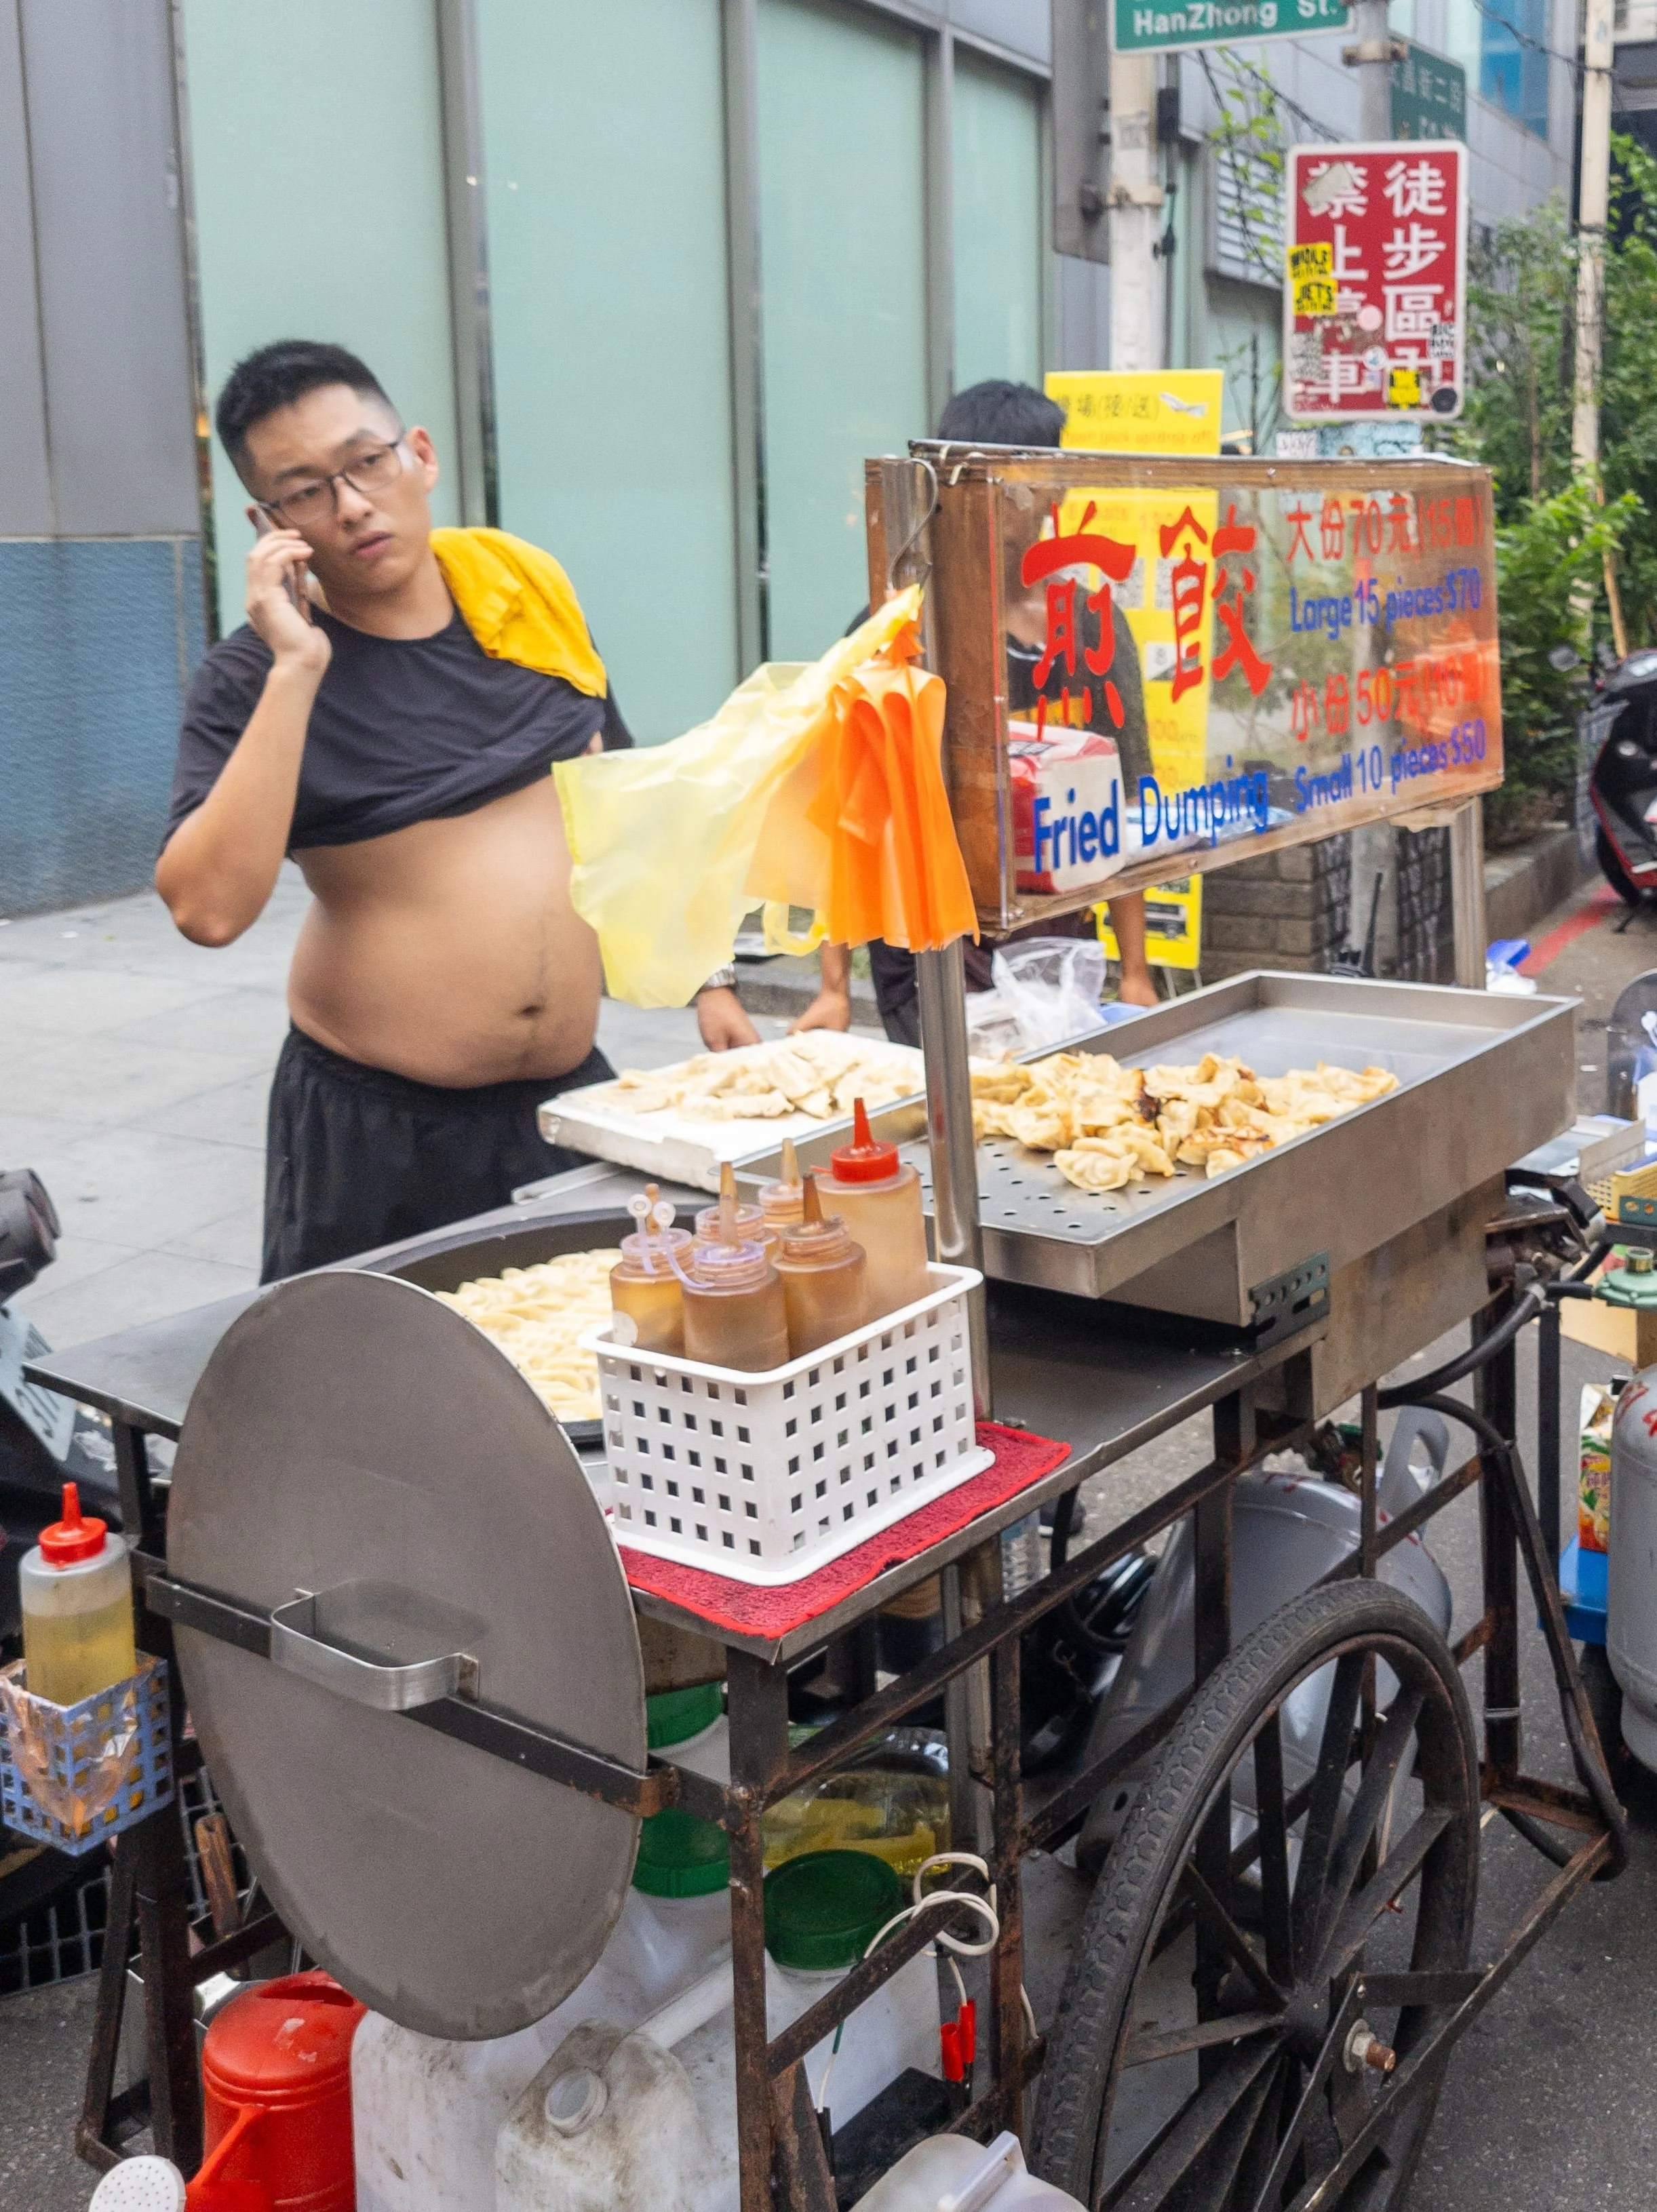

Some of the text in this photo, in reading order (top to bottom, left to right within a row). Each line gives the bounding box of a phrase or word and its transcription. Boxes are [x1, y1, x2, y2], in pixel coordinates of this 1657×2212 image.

[1133, 0, 1339, 37] HanZhong St.
[1021, 500, 1272, 742] 煎餃
[1290, 585, 1352, 640] Large
[1354, 578, 1380, 625] 15
[1386, 575, 1444, 633] pieces
[1033, 753, 1268, 875] Fried Dumping
[1294, 752, 1352, 814] Small
[1357, 745, 1383, 794] 10
[1390, 736, 1448, 795] pieces
